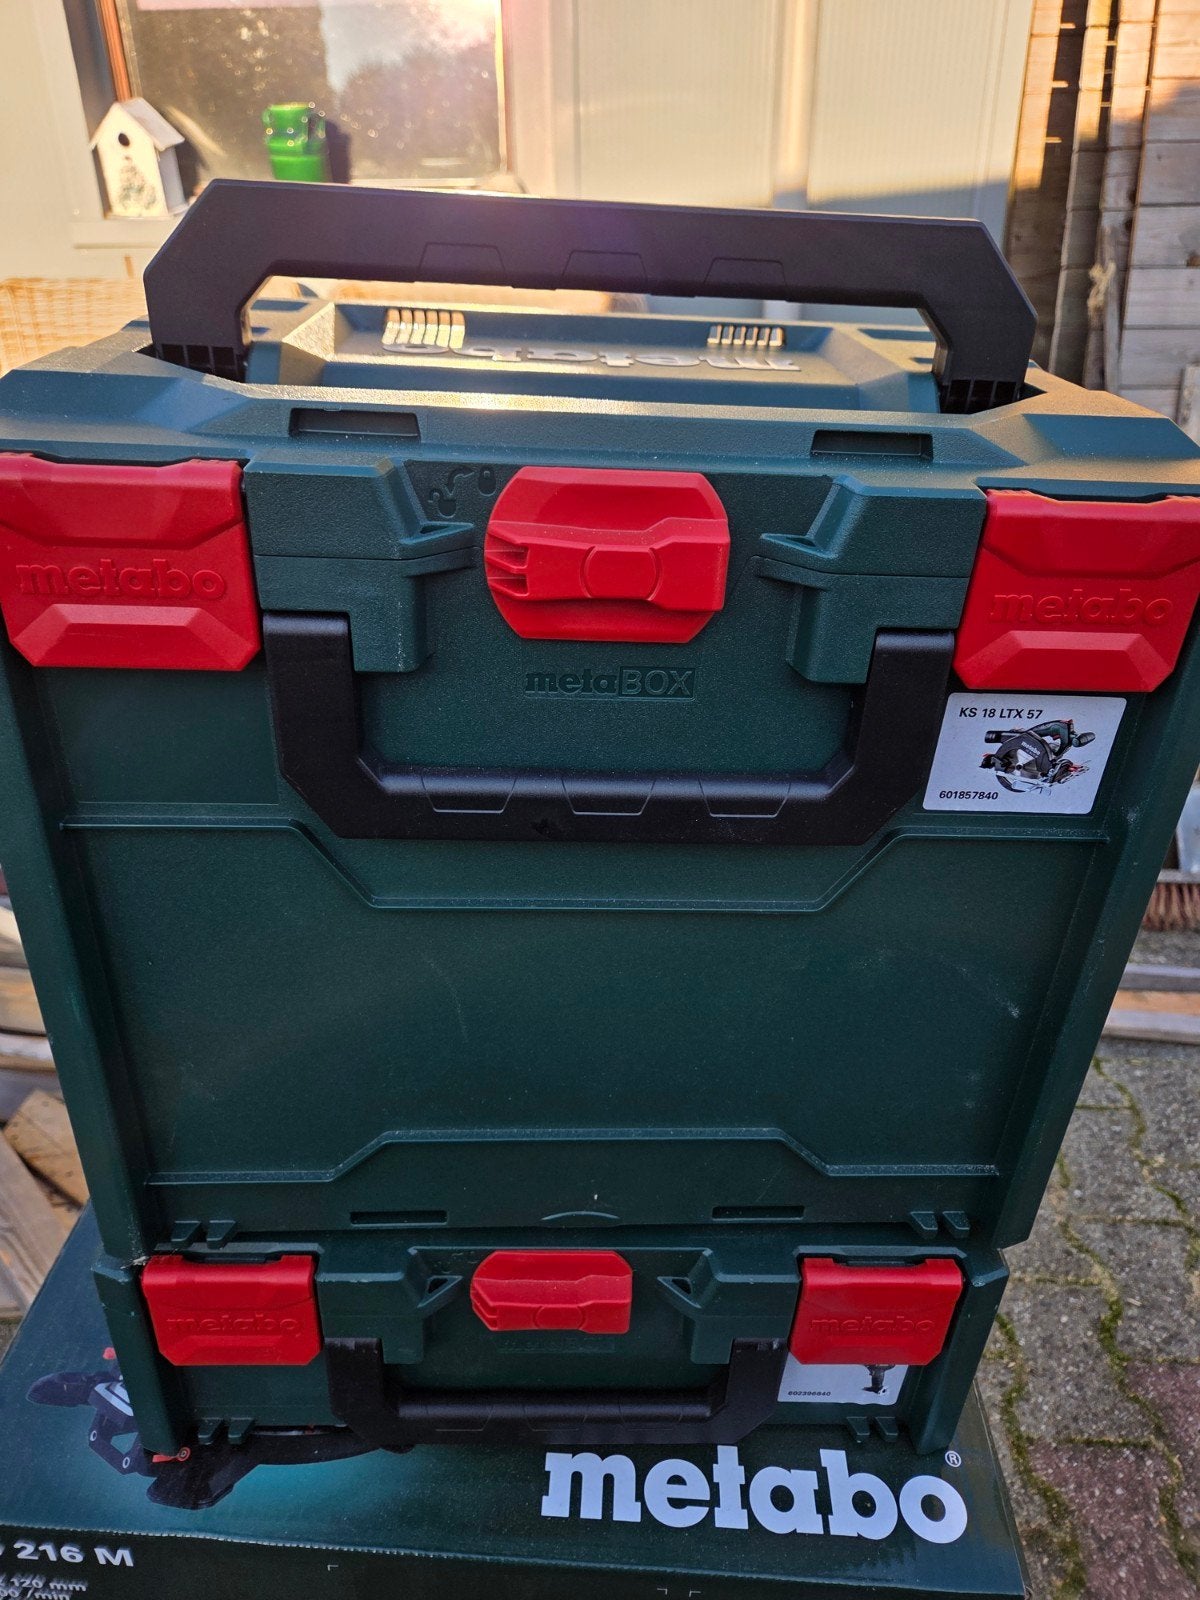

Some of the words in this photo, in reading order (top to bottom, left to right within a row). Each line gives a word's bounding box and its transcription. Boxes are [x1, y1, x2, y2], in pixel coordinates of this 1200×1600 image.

[382, 343, 801, 372] metabo
[15, 558, 226, 599] metabo
[988, 588, 1174, 625] metabo
[525, 667, 696, 699] metaBOX
[959, 707, 977, 718] KS
[983, 708, 996, 718] 18
[999, 708, 1024, 719] LTX
[1027, 709, 1043, 720] 57
[939, 790, 998, 800] 601857840
[165, 1314, 298, 1331] metabo
[810, 1315, 935, 1332] metabo
[541, 1445, 968, 1544] metabo
[13, 1541, 84, 1563] 216
[94, 1547, 134, 1567] M
[11, 1577, 44, 1589] 120
[49, 1582, 87, 1592] mm
